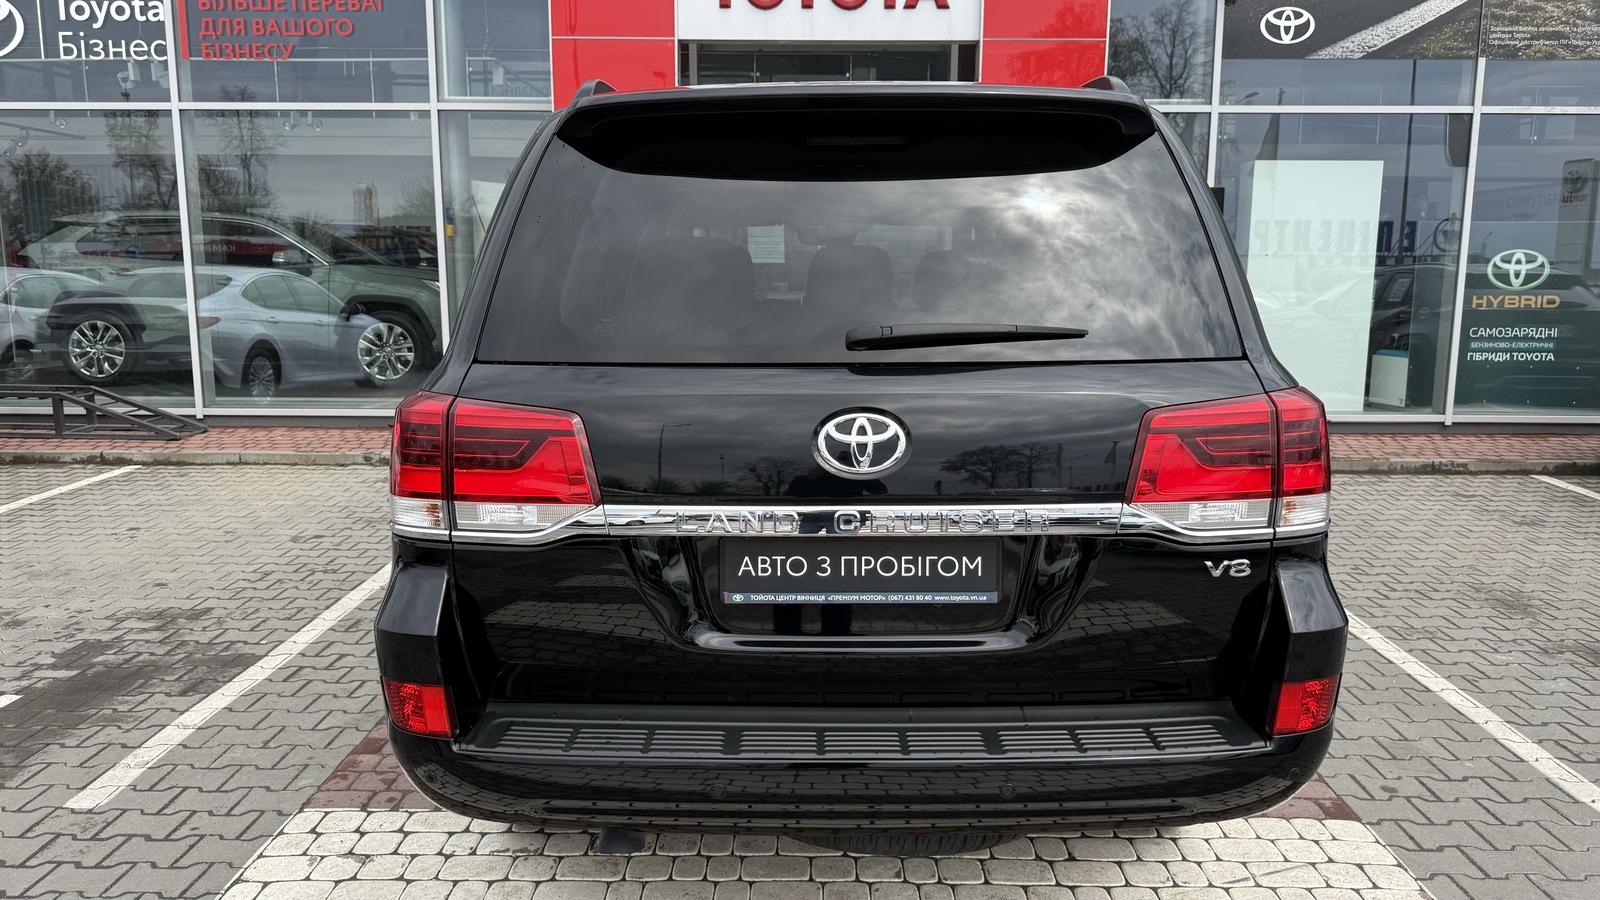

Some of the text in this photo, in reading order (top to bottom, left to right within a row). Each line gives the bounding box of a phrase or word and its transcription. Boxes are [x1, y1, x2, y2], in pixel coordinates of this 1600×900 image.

[200, 18, 353, 38] ДЛЯ ВАШОГО
[58, 31, 168, 60] Бізнес
[202, 42, 293, 60] БІЗНЕСУ
[1471, 295, 1560, 308] HYBRID
[1469, 327, 1558, 339] САМОЗАРЯДНІ
[1467, 352, 1555, 362] ГІБРИДИ TOYOTA
[676, 509, 1050, 534] LAND CRUISER
[737, 555, 982, 577] АВТО З ПРОБІГОМ
[1203, 558, 1251, 578] V8
[750, 593, 775, 601] ТОЙОТА
[776, 594, 796, 602] ЦЕНТР
[797, 594, 825, 602] ВІННИЦЯ
[888, 594, 904, 602] (067)
